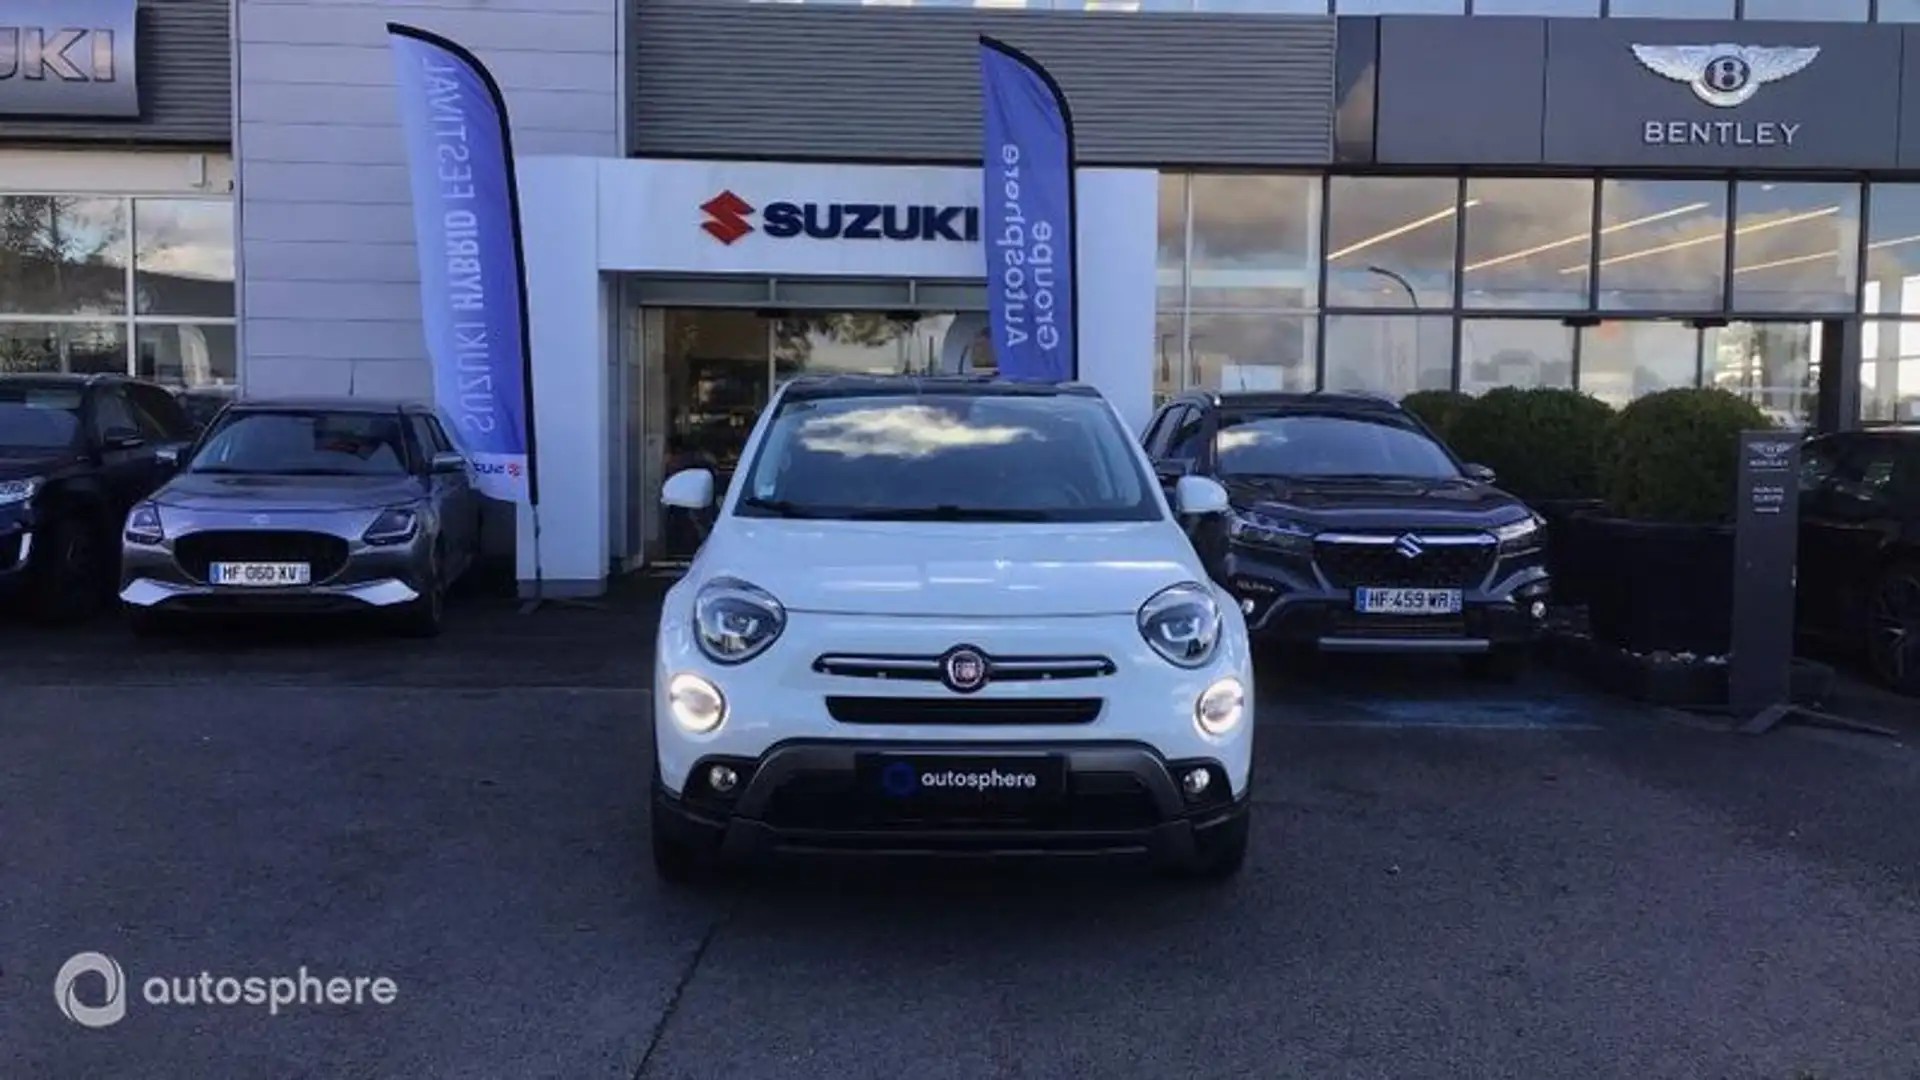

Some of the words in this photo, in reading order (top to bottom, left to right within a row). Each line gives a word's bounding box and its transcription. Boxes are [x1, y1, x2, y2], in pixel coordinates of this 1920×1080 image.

[1643, 120, 1801, 145] BENTLEY
[762, 202, 980, 242] SUZUKI
[920, 768, 1038, 792] autosphere
